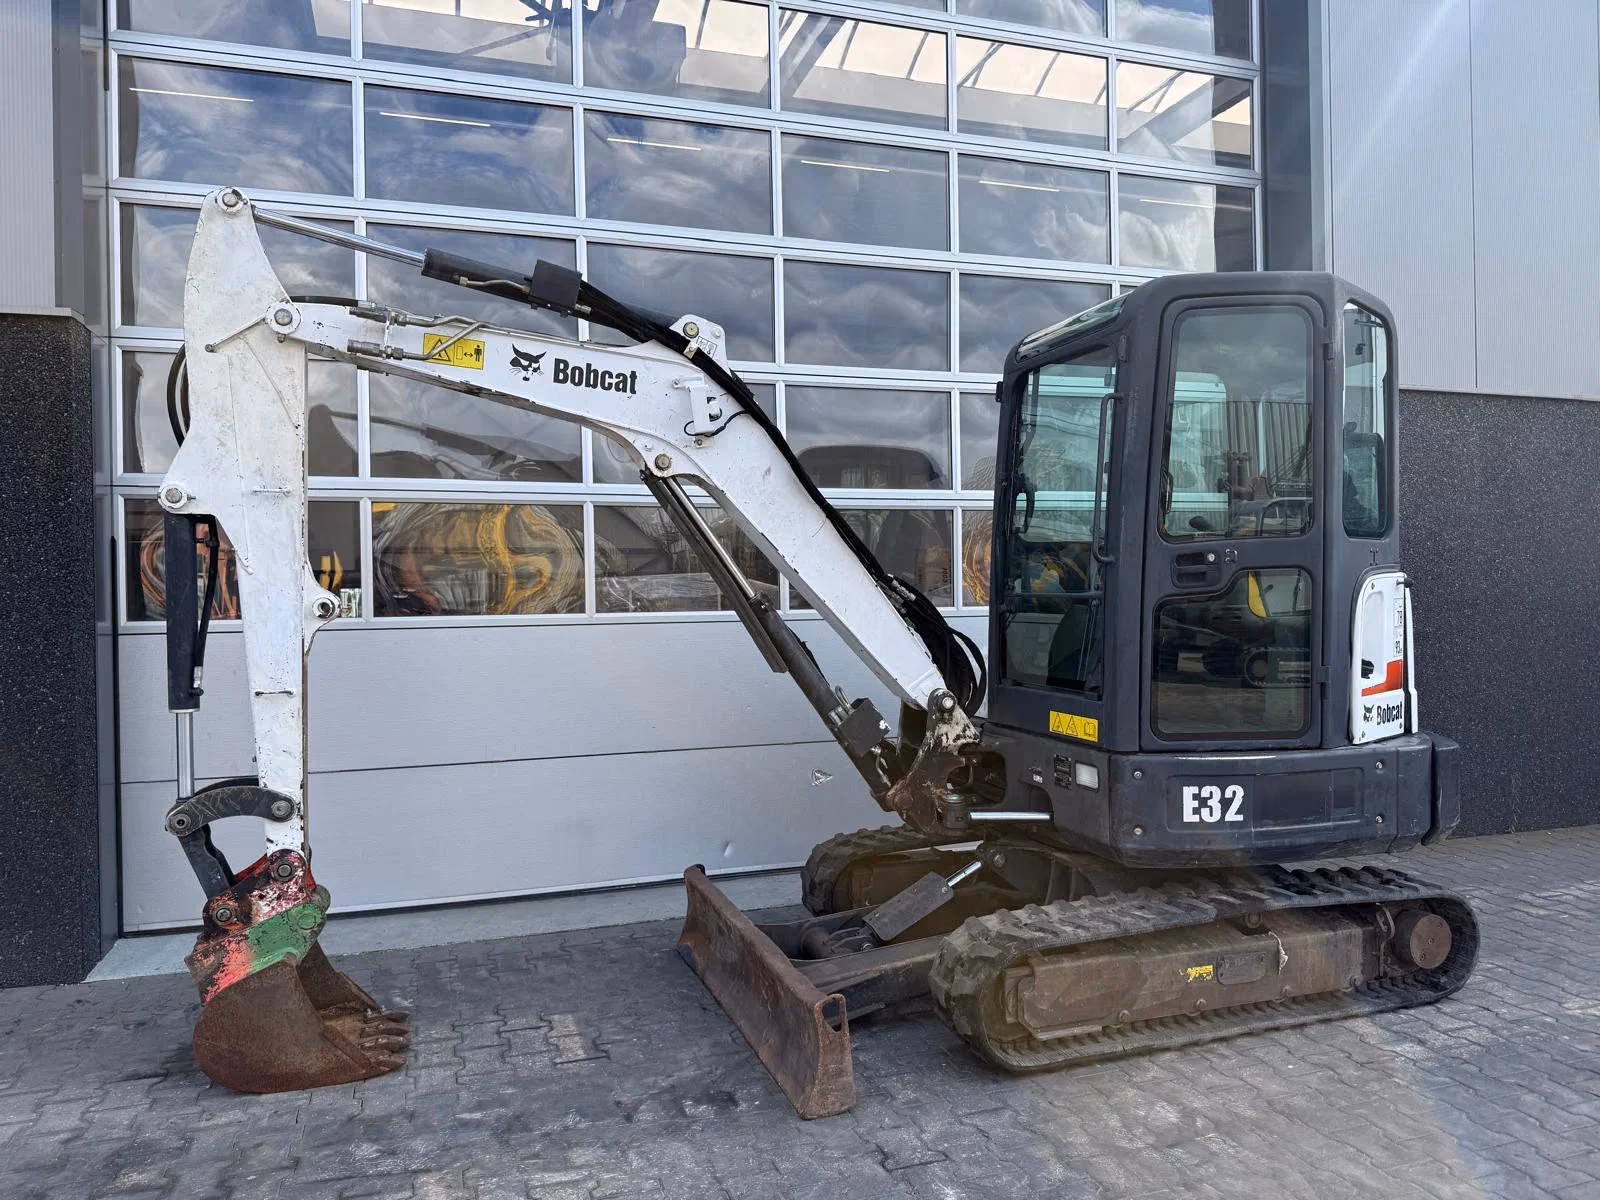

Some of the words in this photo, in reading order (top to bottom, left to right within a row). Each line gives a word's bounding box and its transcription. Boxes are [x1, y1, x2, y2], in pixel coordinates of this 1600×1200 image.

[553, 358, 637, 394] Bobcat
[1376, 701, 1402, 726] Bobcat
[1182, 785, 1244, 823] E32
